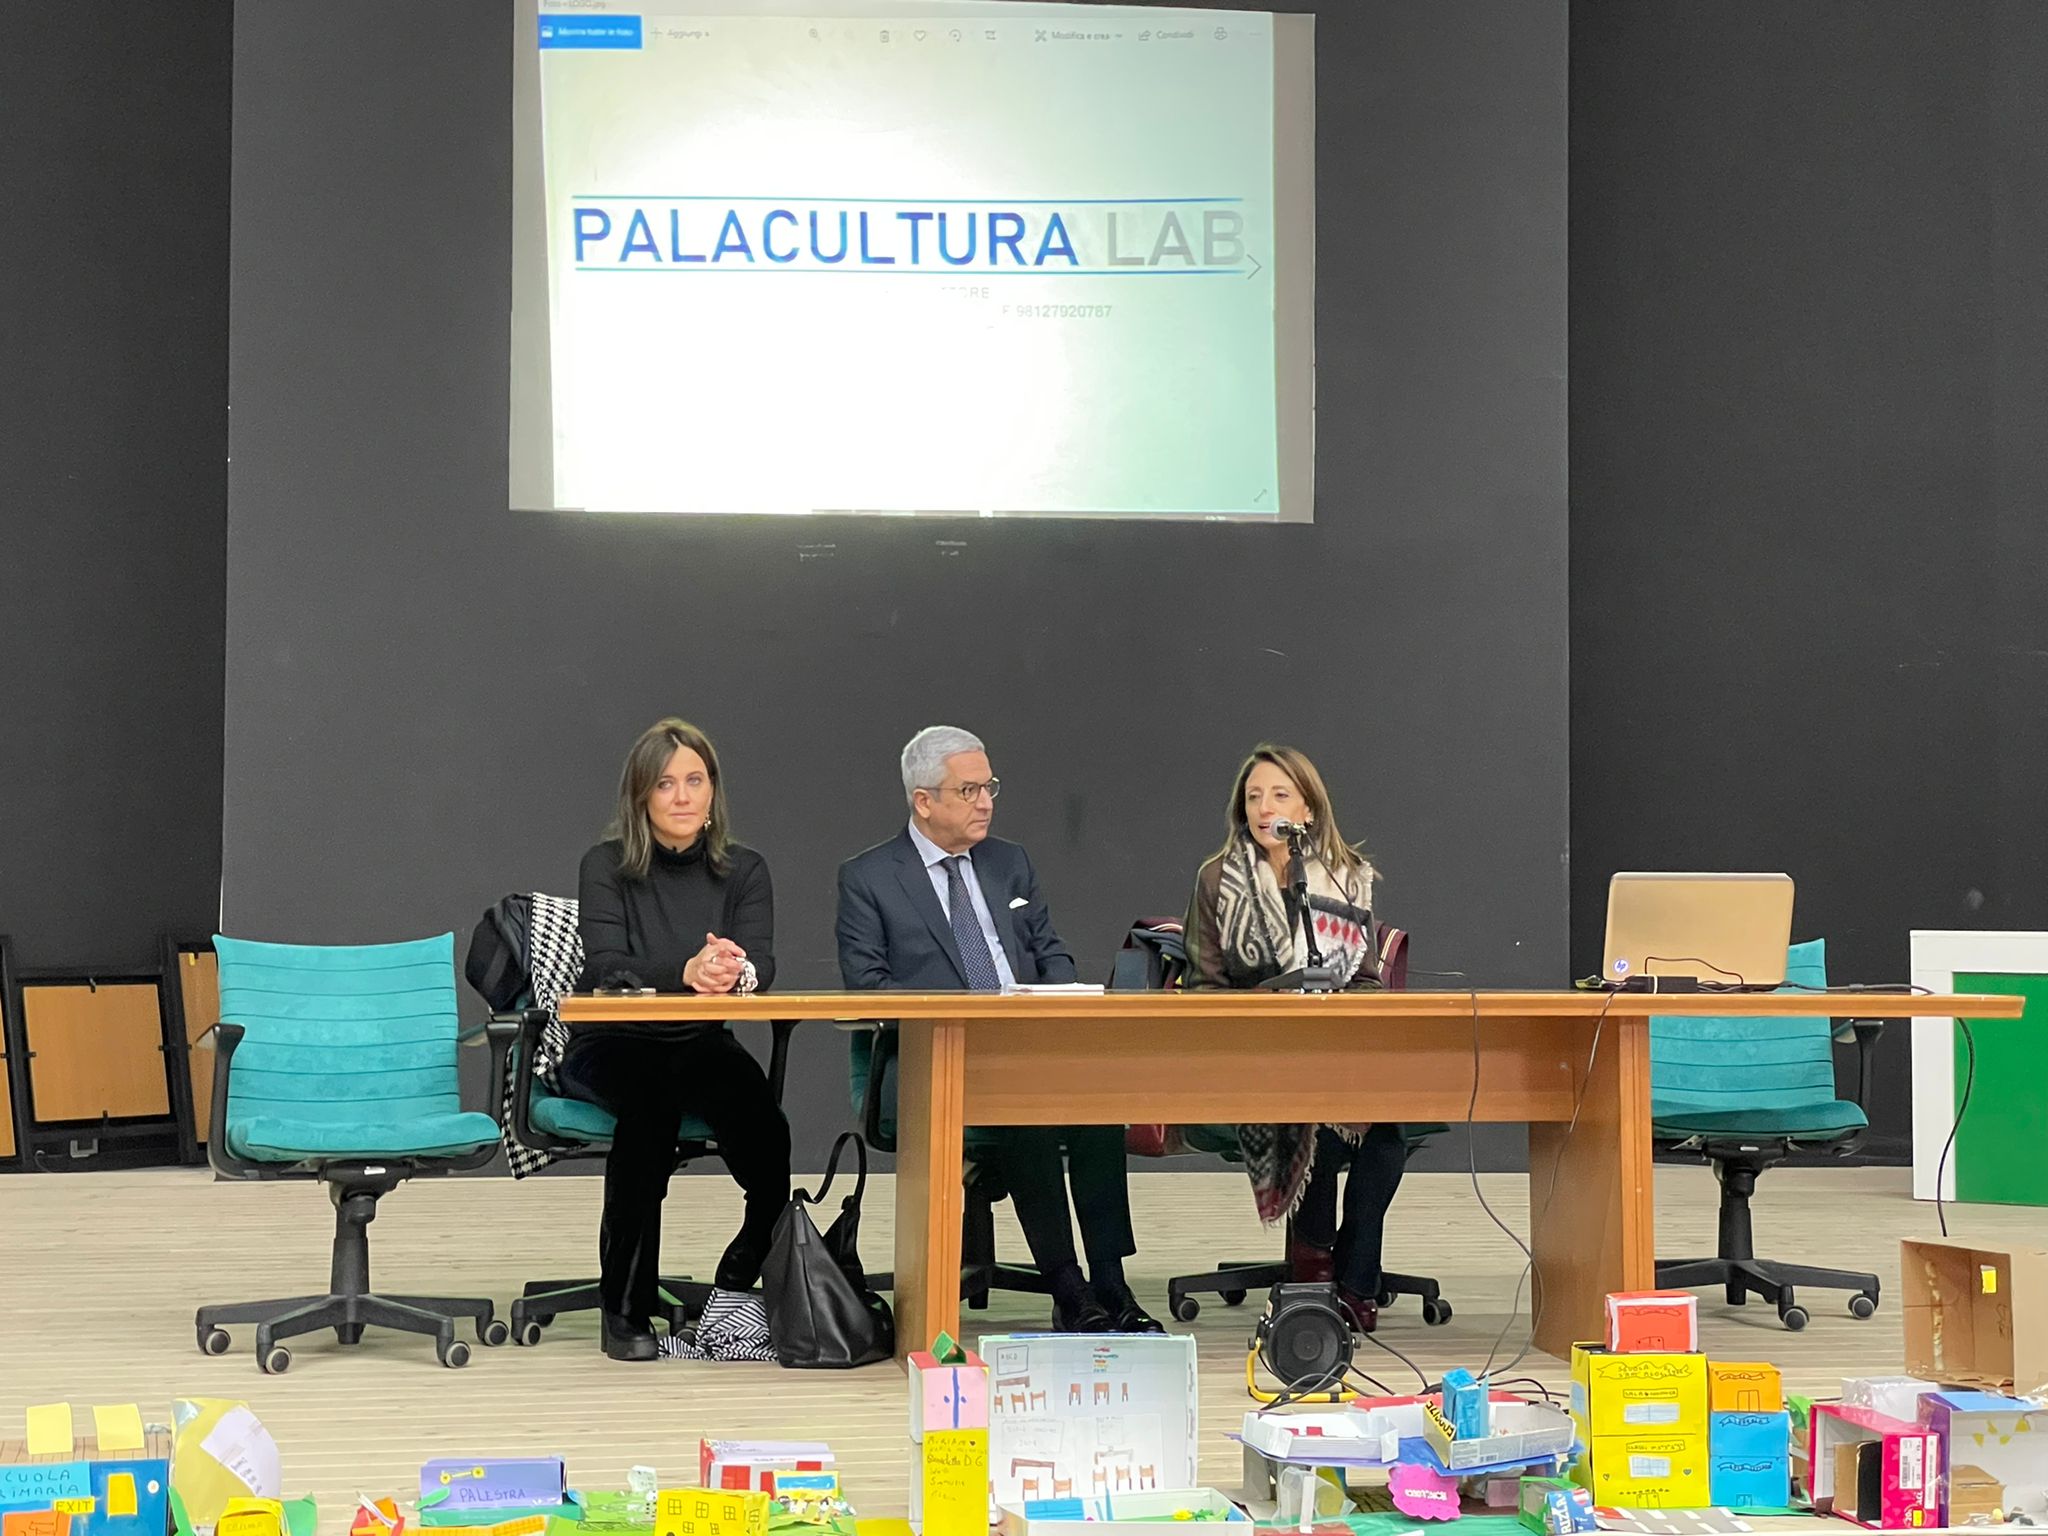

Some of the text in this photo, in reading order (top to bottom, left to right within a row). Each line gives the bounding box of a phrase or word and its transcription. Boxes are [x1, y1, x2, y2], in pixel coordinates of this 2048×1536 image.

[573, 208, 1246, 267] PALACULTURA LAB
[1016, 304, 1113, 318] 98127920787
[459, 1487, 526, 1503] PALESTRA
